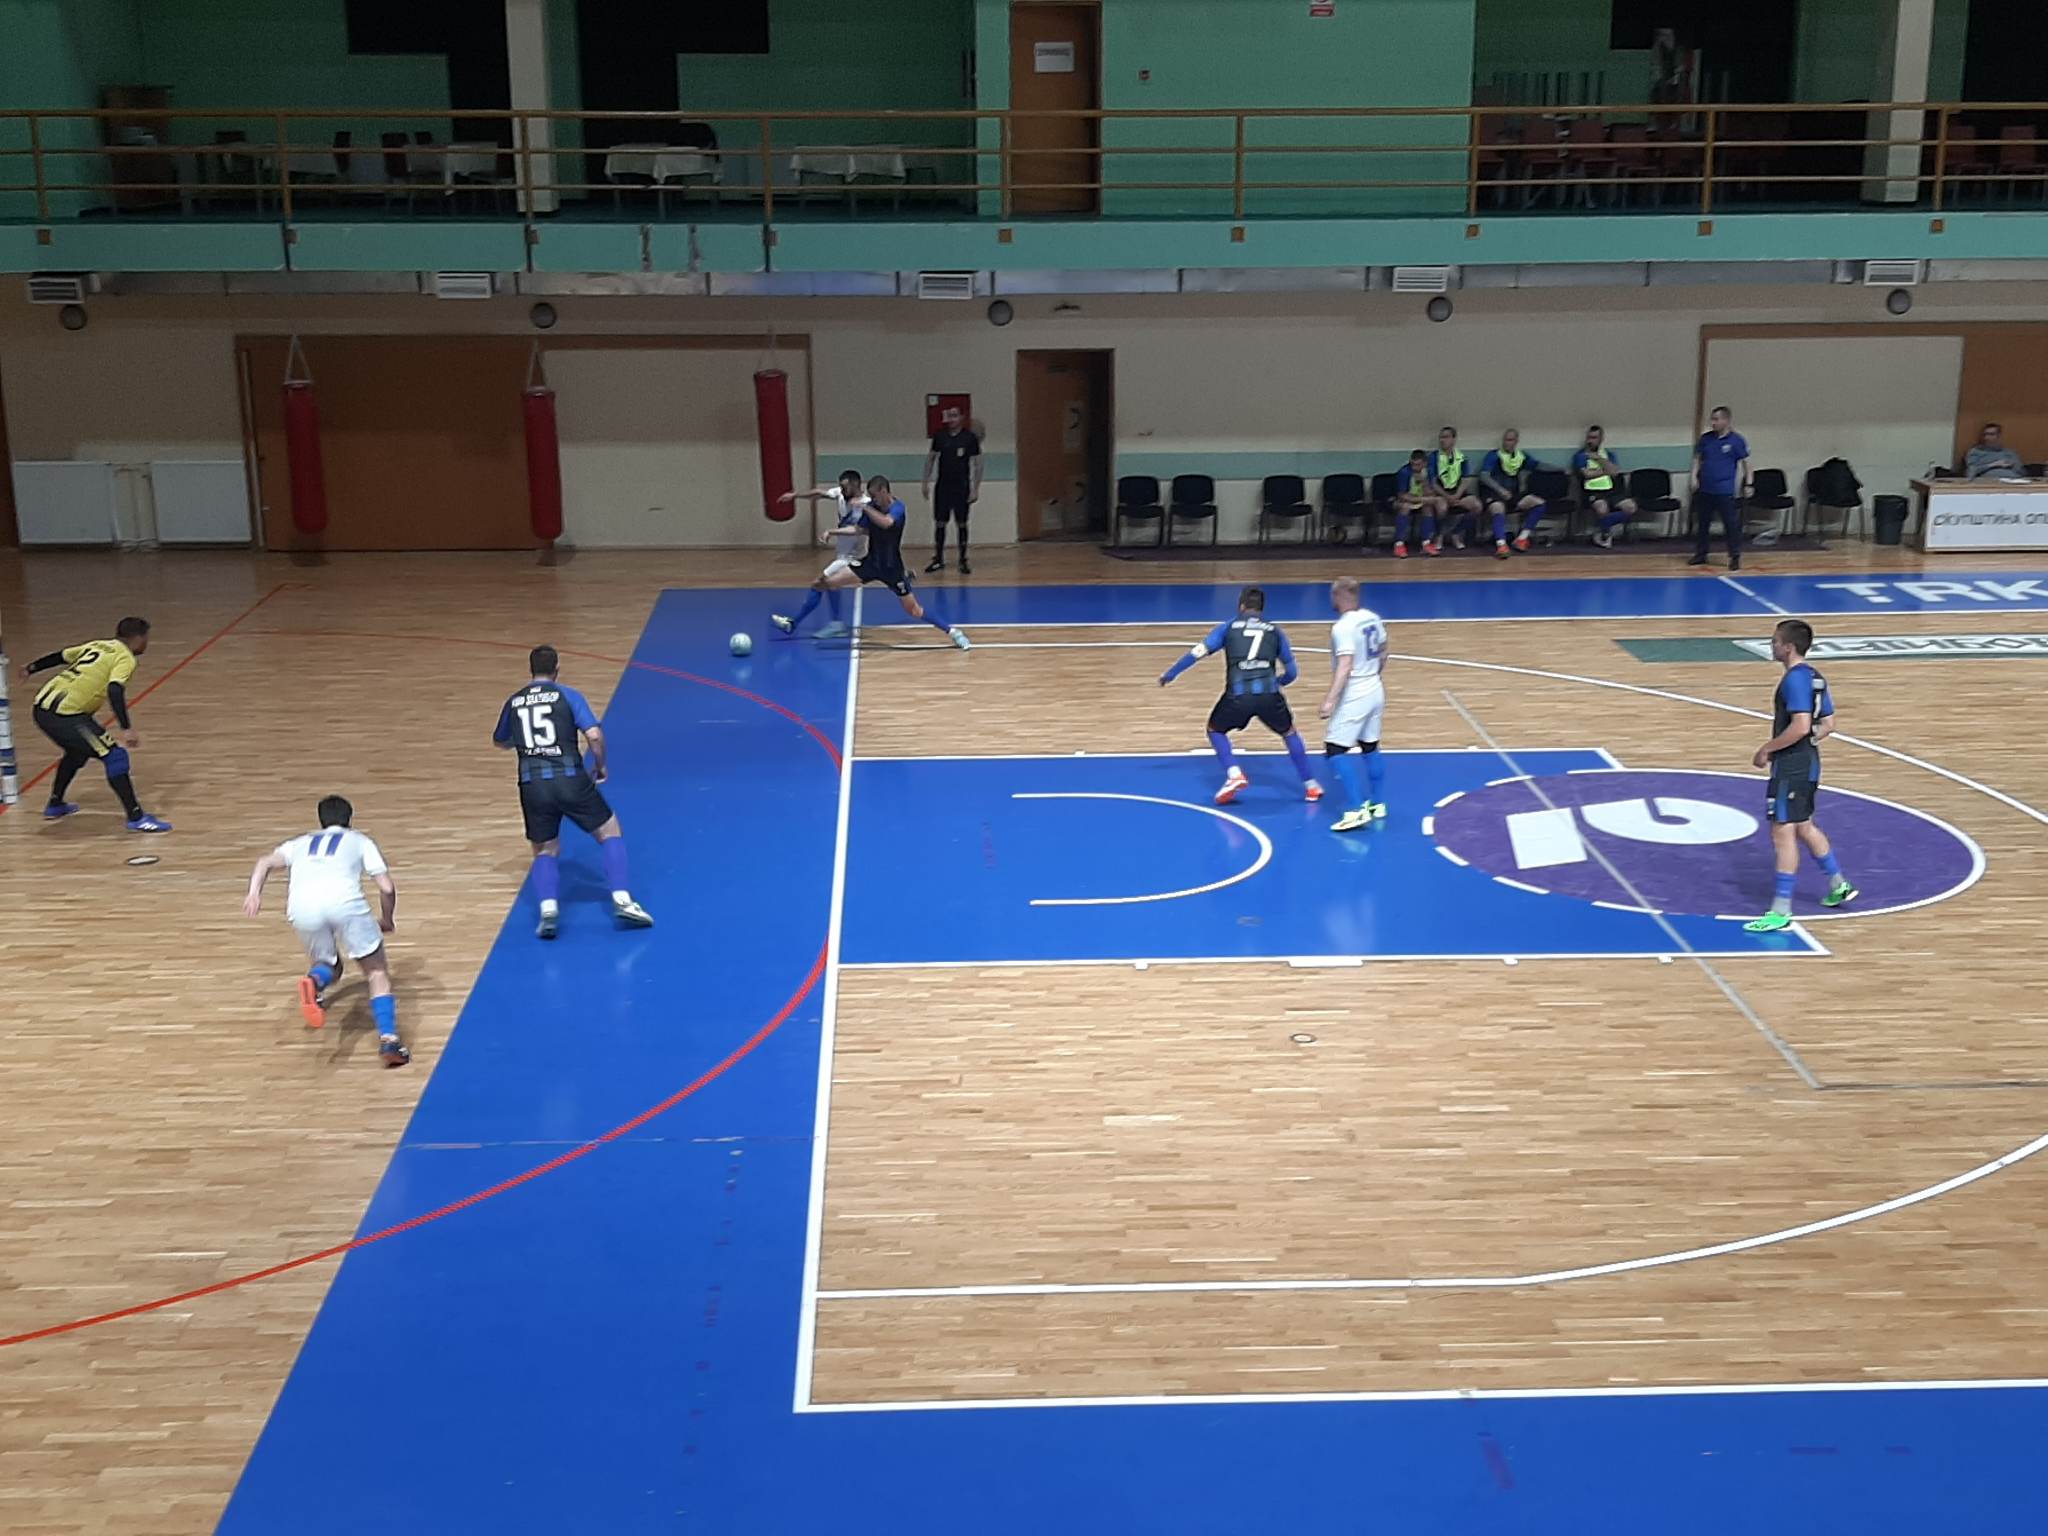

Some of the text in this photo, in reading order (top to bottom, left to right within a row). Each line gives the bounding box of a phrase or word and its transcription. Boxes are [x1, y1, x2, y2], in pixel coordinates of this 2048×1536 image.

[1242, 629, 1265, 661] 7
[517, 704, 557, 749] 15
[307, 832, 345, 856] 11
